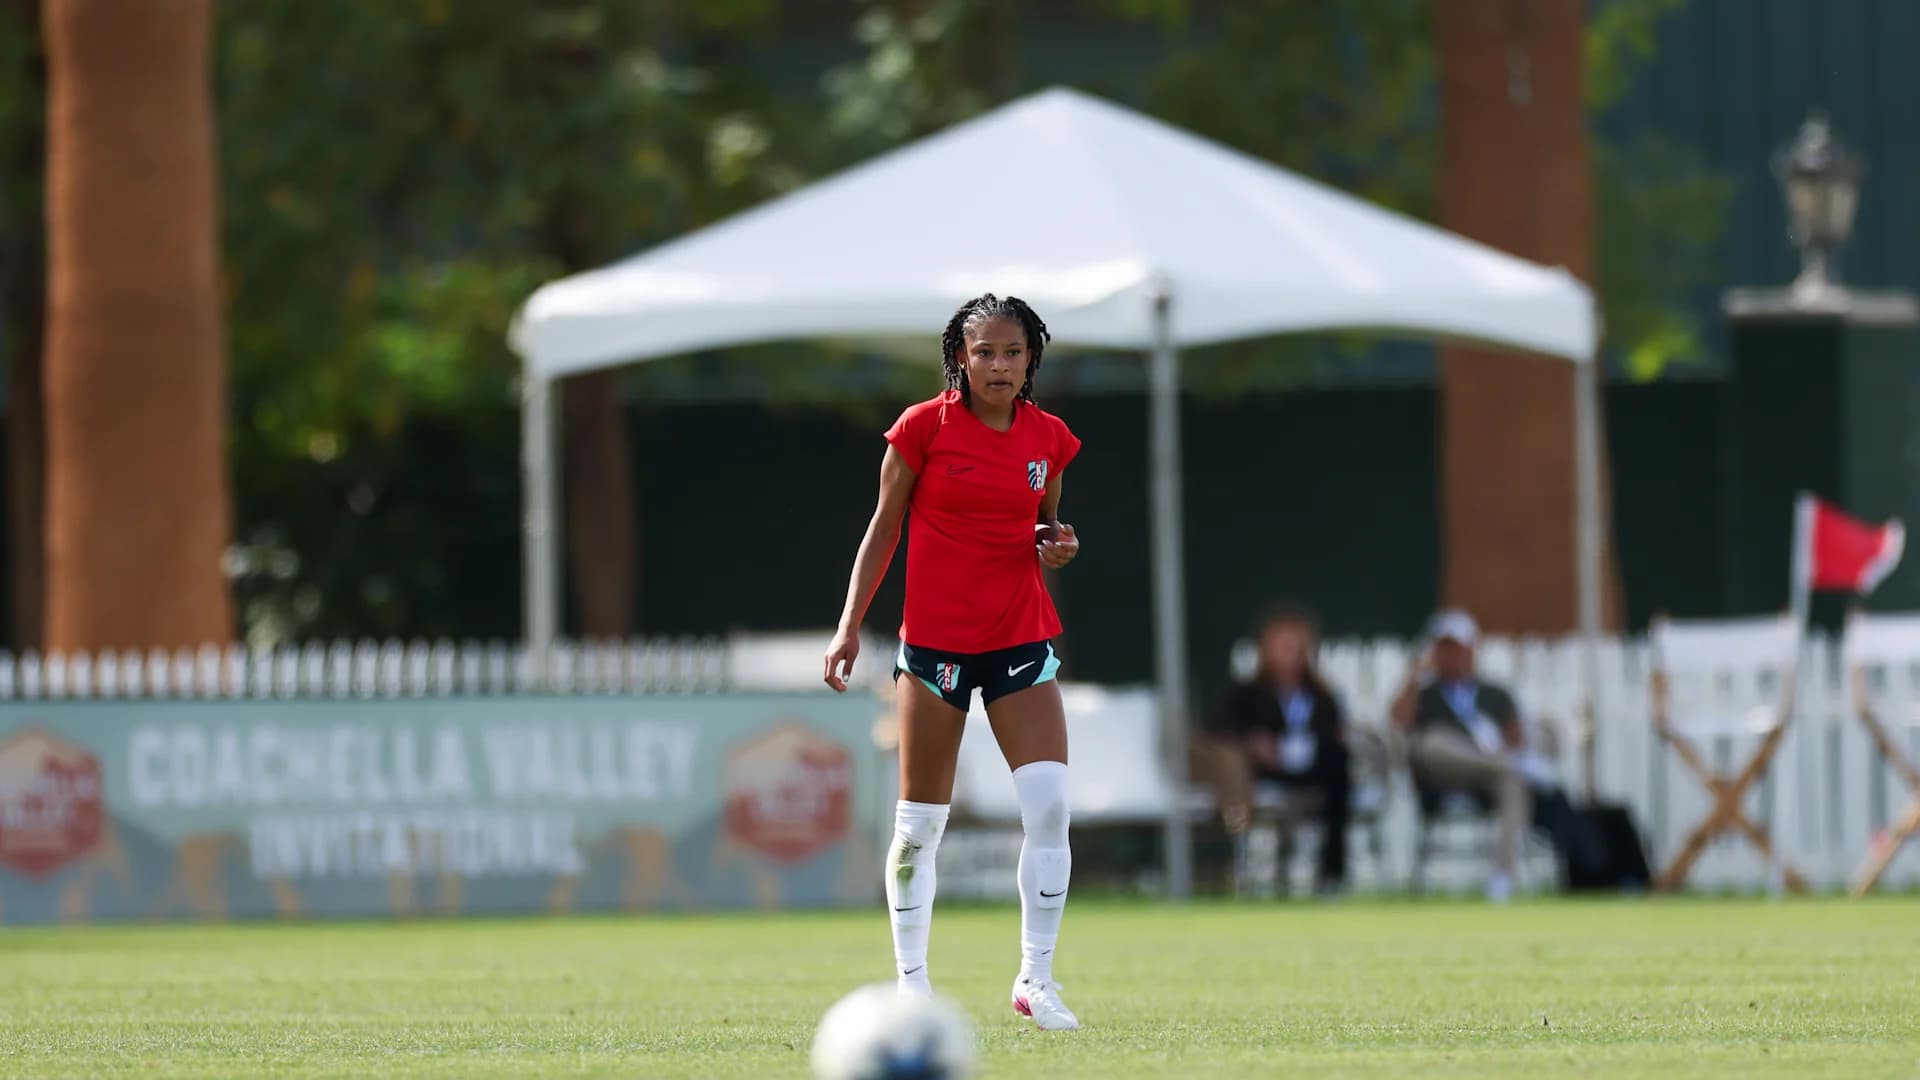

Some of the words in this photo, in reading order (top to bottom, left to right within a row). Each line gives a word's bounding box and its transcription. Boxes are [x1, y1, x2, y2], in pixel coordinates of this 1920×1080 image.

[129, 726, 472, 804] COACHELLA
[484, 722, 700, 800] VALLEY
[252, 813, 588, 880] INVITATIONAL
